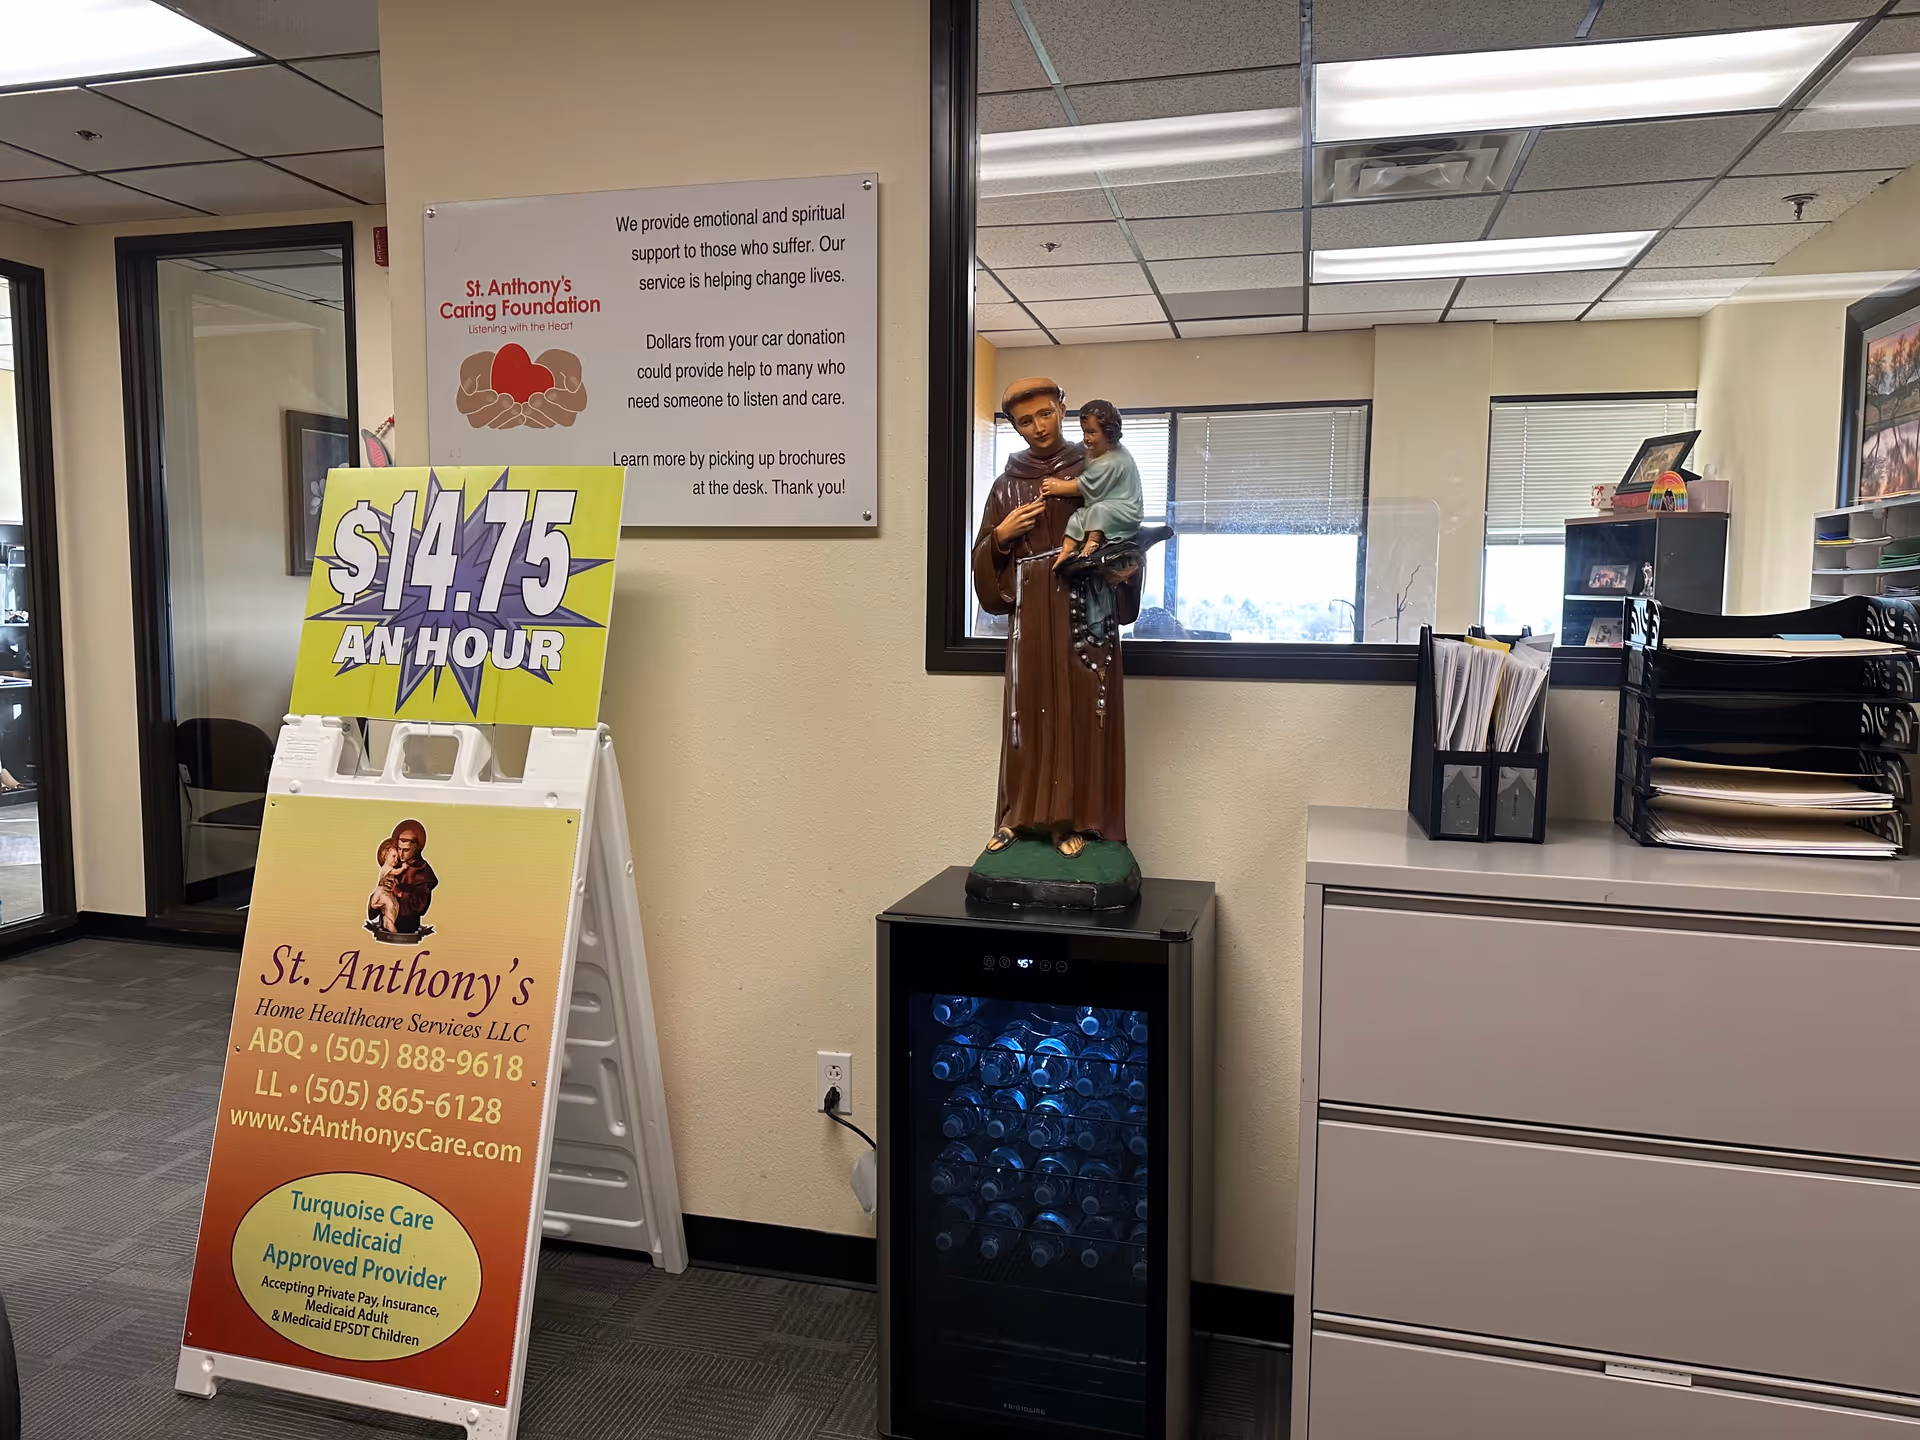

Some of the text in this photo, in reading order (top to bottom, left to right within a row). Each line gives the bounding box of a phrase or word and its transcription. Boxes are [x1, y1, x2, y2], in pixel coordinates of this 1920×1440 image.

[616, 204, 845, 234] We provide emotional and spiritual
[631, 235, 846, 263] support to those who suffer. Our
[465, 275, 571, 298] St. Anthony's
[639, 268, 845, 291] service is helping change lives.
[440, 296, 600, 321] Caring Foundation
[468, 321, 573, 335] Listening with the Heart
[646, 329, 845, 351] Dollars from your car donation
[637, 359, 846, 383] could provide help to many who
[627, 390, 845, 409] need someone to listen and care.
[613, 450, 846, 470] Learn more by picking up brochures
[693, 479, 846, 498] at the desk. Thank you!
[328, 490, 578, 616] $14.75
[332, 625, 565, 671] AN HOUR
[260, 944, 535, 1018] St. Anthony's
[254, 998, 530, 1043] Home Healthcare Services LLC
[248, 1027, 523, 1081] ABQ (505) 888-9618
[255, 1069, 502, 1125] LL (505) 865-6128
[229, 1108, 521, 1163] www.StAnthonysCare.com
[291, 1190, 434, 1230] Turquoise Care
[313, 1221, 403, 1255] Medicaid
[263, 1243, 447, 1291] Approved Provider
[261, 1275, 440, 1318] Accepting Private Pay, Insurance,
[305, 1299, 389, 1324] Medicaid Adult
[271, 1309, 420, 1347] & Medicaid EPSDT Children
[1003, 1403, 1046, 1416] FRIGIDAIRE
